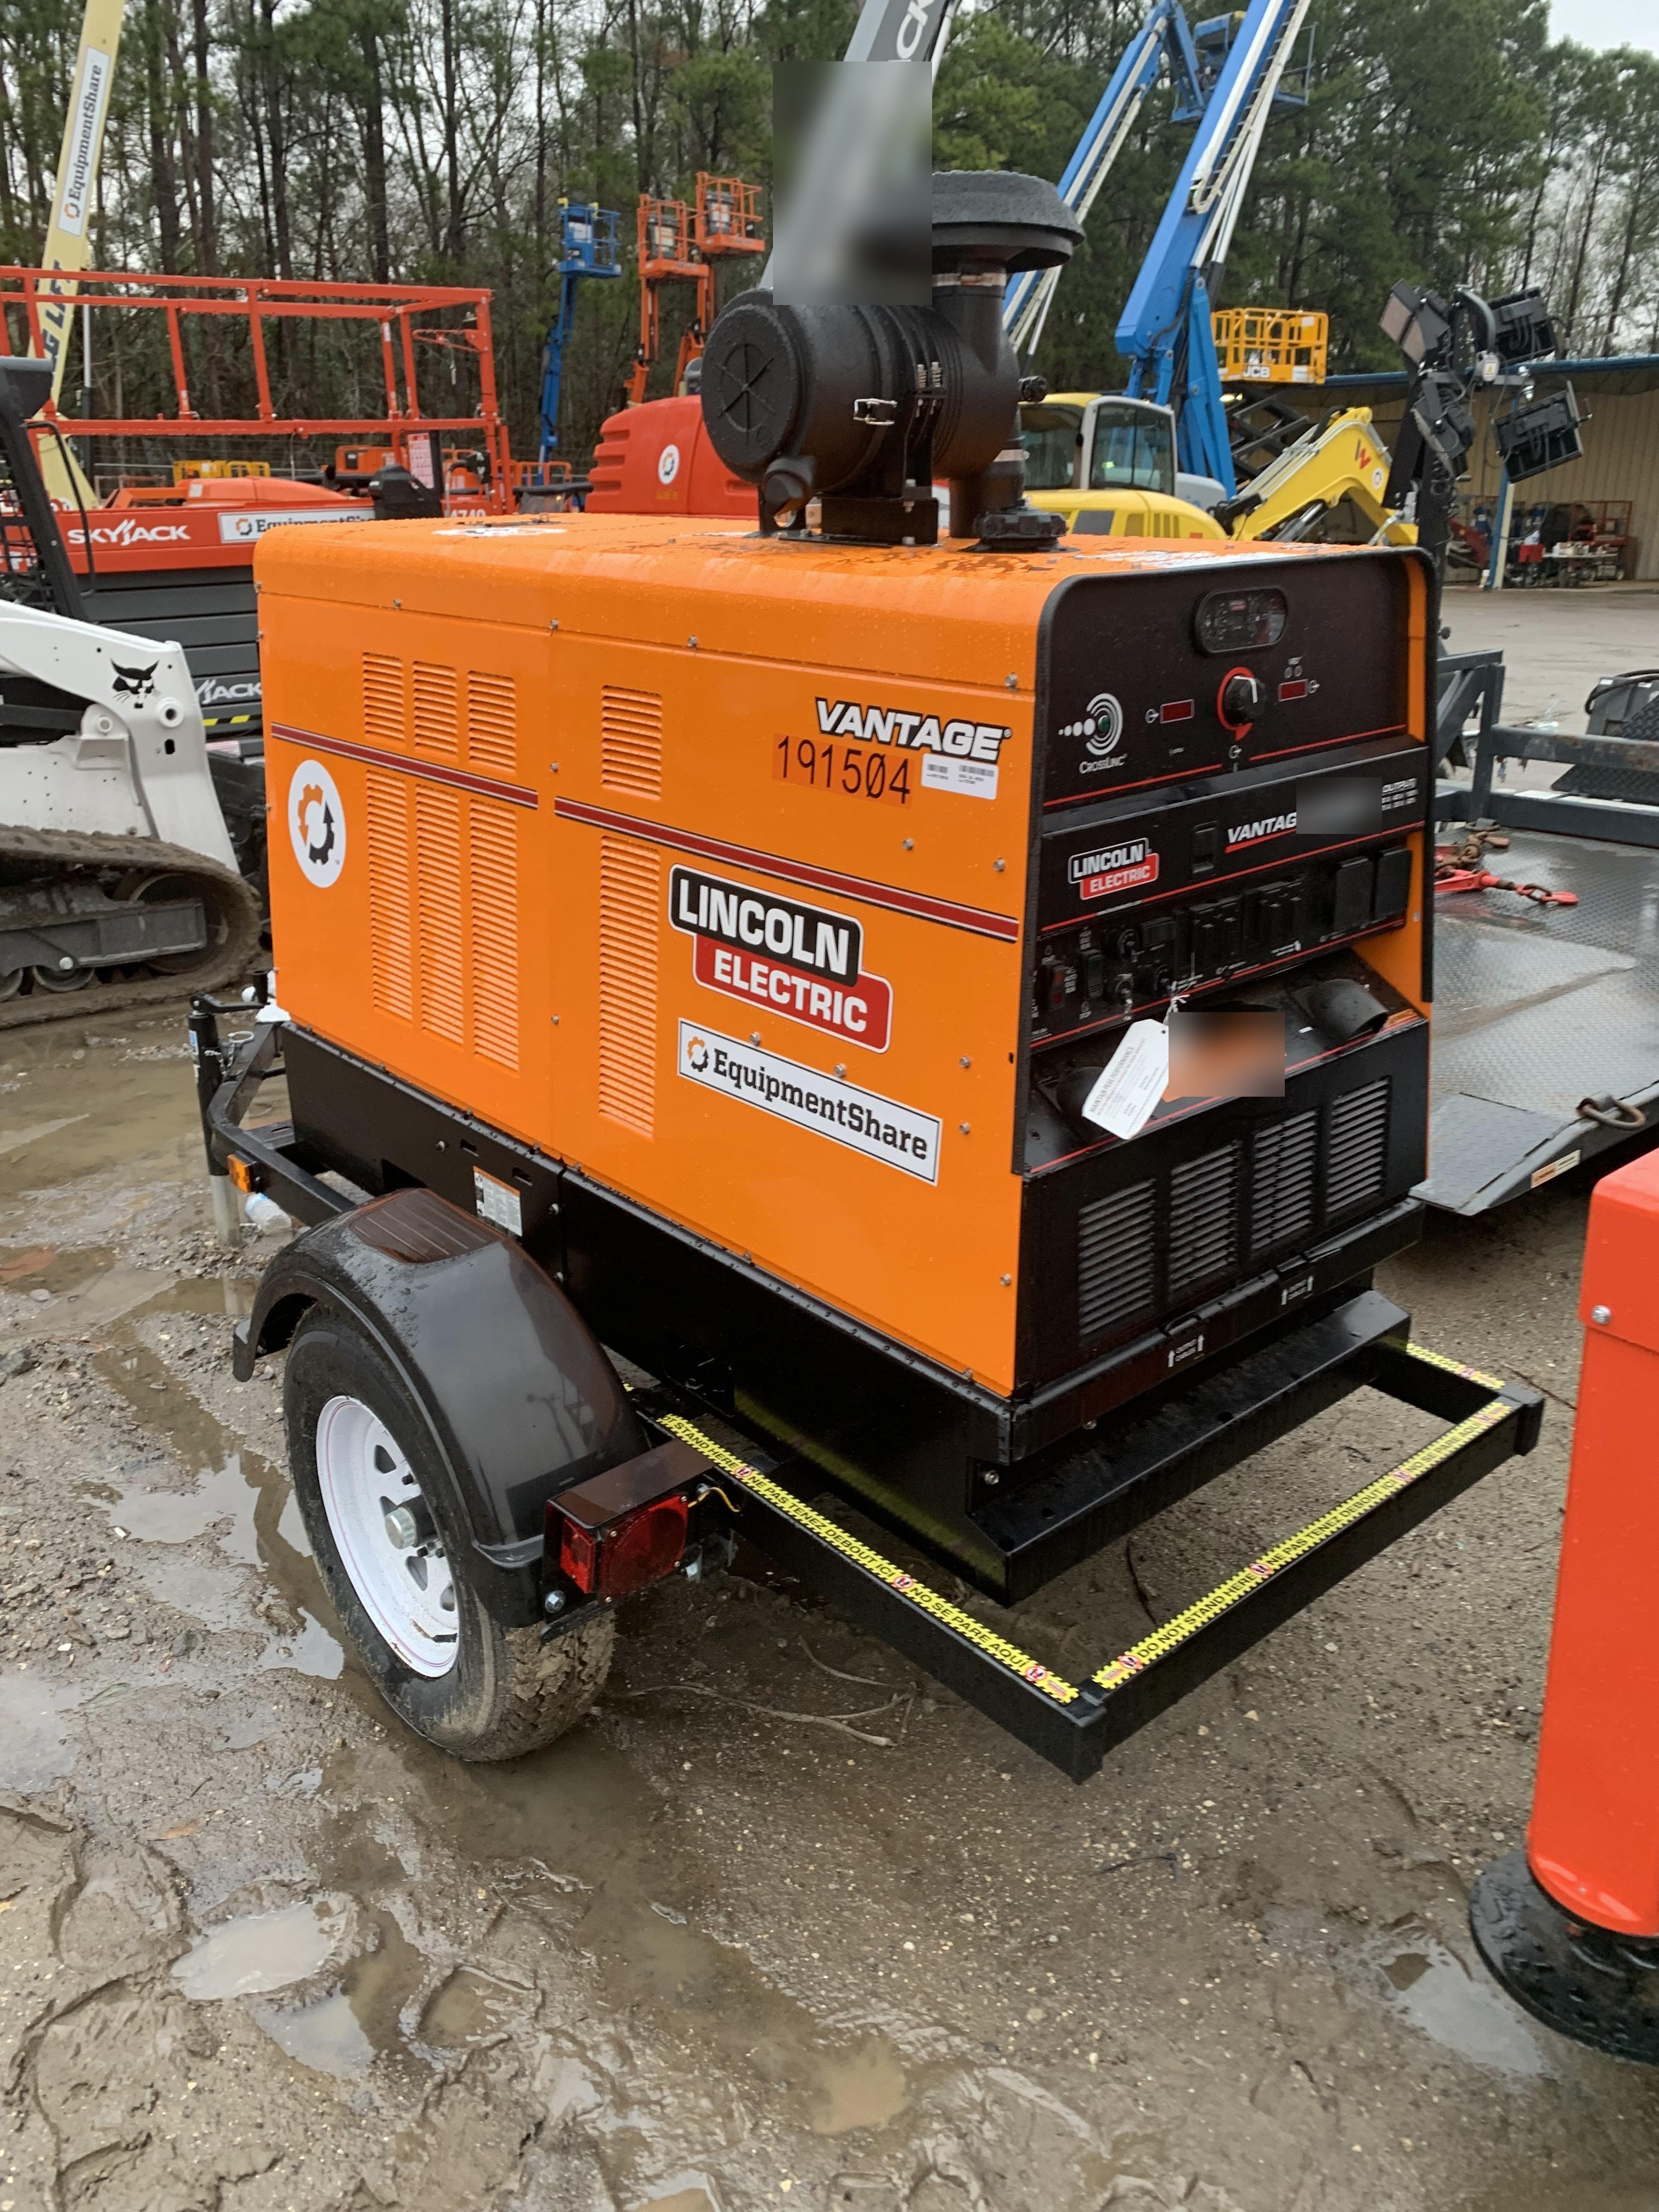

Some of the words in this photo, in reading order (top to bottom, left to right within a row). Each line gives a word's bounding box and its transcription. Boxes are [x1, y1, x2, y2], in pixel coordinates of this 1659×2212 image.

[888, 0, 934, 61] CK
[68, 64, 103, 201] EquipmentShare
[1243, 365, 1271, 377] JCB
[67, 518, 191, 546] SKYJACK
[815, 698, 1005, 763] VANTAGE
[778, 734, 911, 804] 191504
[1073, 844, 1144, 878] LINCOLN
[1227, 812, 1296, 843] VANTAG
[1090, 865, 1150, 893] ELECTRIC
[679, 878, 849, 975] LINCOLN
[714, 949, 868, 1032] ELECTRIC
[714, 1048, 928, 1160] EquipmentShare
[674, 1422, 709, 1449] STAND
[708, 1448, 739, 1468] HERE
[748, 1476, 766, 1488] NE
[764, 1487, 789, 1504] PAS
[789, 1503, 827, 1530] TENEZ
[825, 1529, 878, 1564] DEBOUT
[876, 1564, 896, 1577] ICI
[910, 1587, 932, 1602] NO
[932, 1602, 952, 1617] SE
[951, 1616, 991, 1643] PARE
[1137, 1643, 1160, 1658] DO
[1159, 1624, 1186, 1644] NOT
[1184, 1595, 1226, 1625] STAND
[1223, 1572, 1256, 1597] HERE
[1267, 1553, 1285, 1566] NE
[1283, 1538, 1309, 1555] PAS
[1305, 1516, 1341, 1540] TENEZ
[1340, 1489, 1384, 1517] DEBOUT
[1380, 1479, 1398, 1491] ICI
[1406, 1462, 1424, 1472] NO
[1421, 1452, 1436, 1462] SE
[1434, 1436, 1462, 1453] PARE
